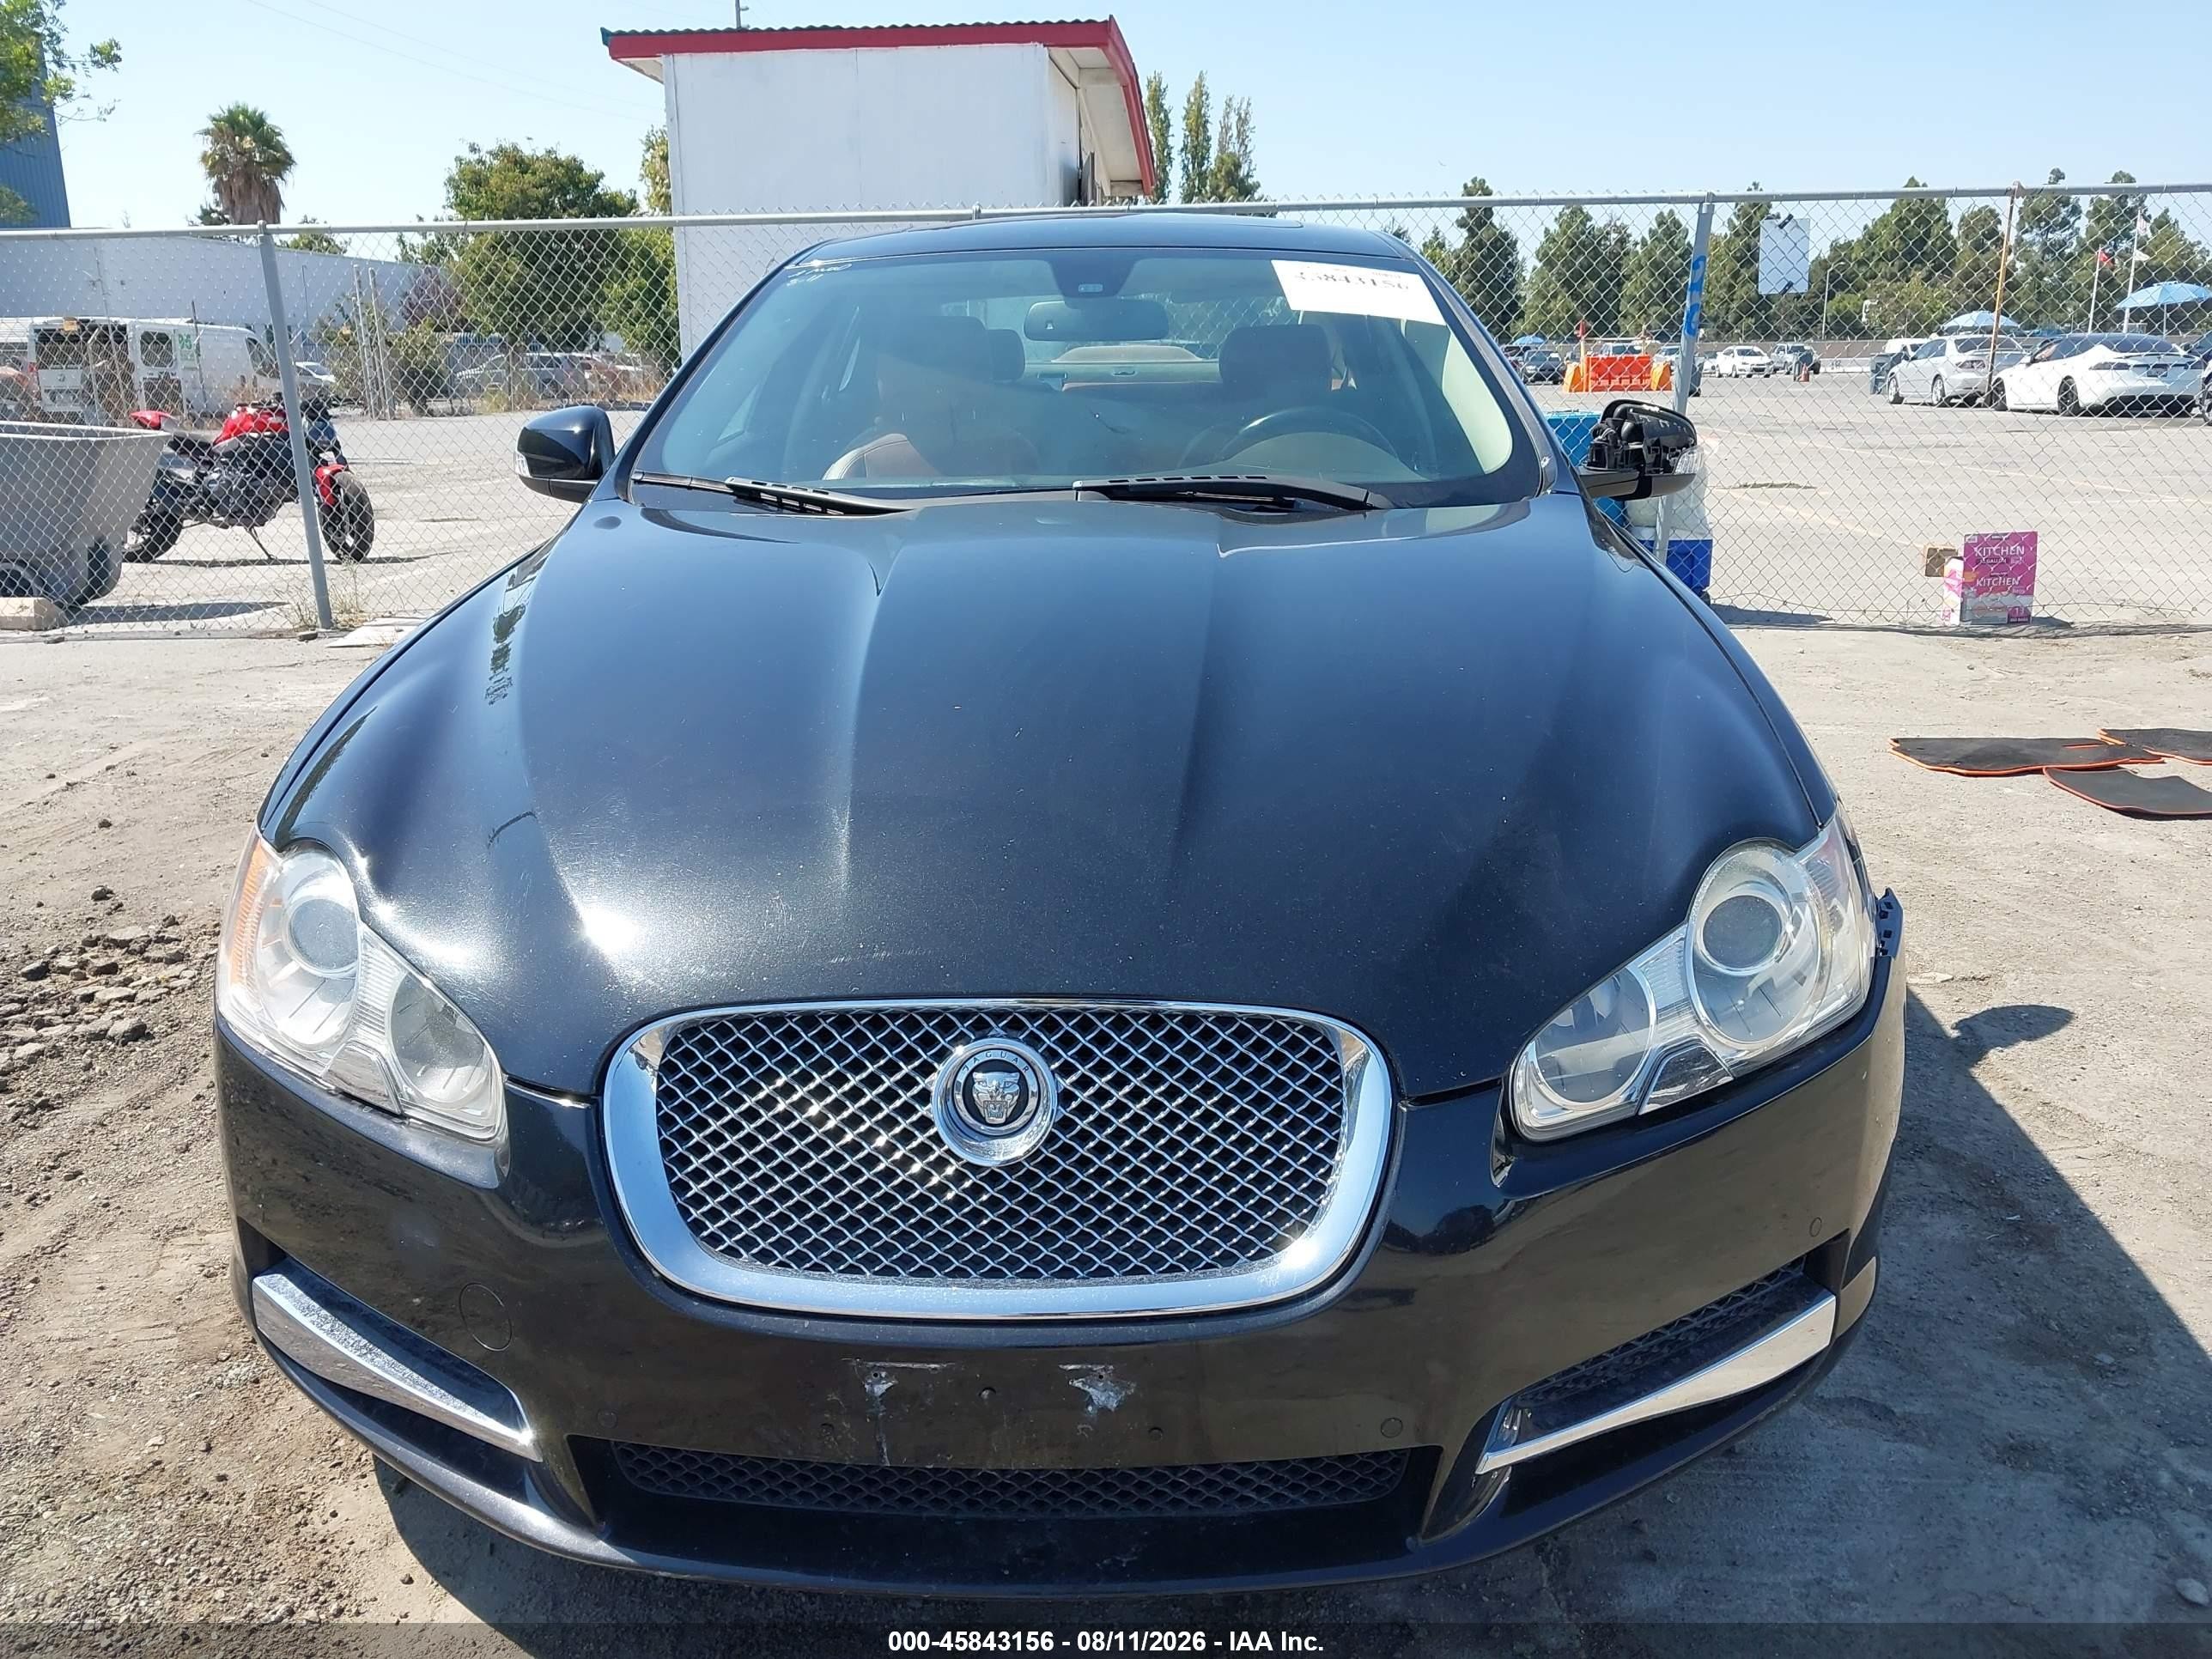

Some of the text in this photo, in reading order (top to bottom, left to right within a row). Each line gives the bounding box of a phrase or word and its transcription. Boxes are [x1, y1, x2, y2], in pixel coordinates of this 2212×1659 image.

[1295, 270, 1409, 290] 843156
[1975, 545, 2025, 556] KITCHEN
[1977, 577, 2019, 586] KITCHEN
[962, 1051, 1030, 1073] JAGUAR
